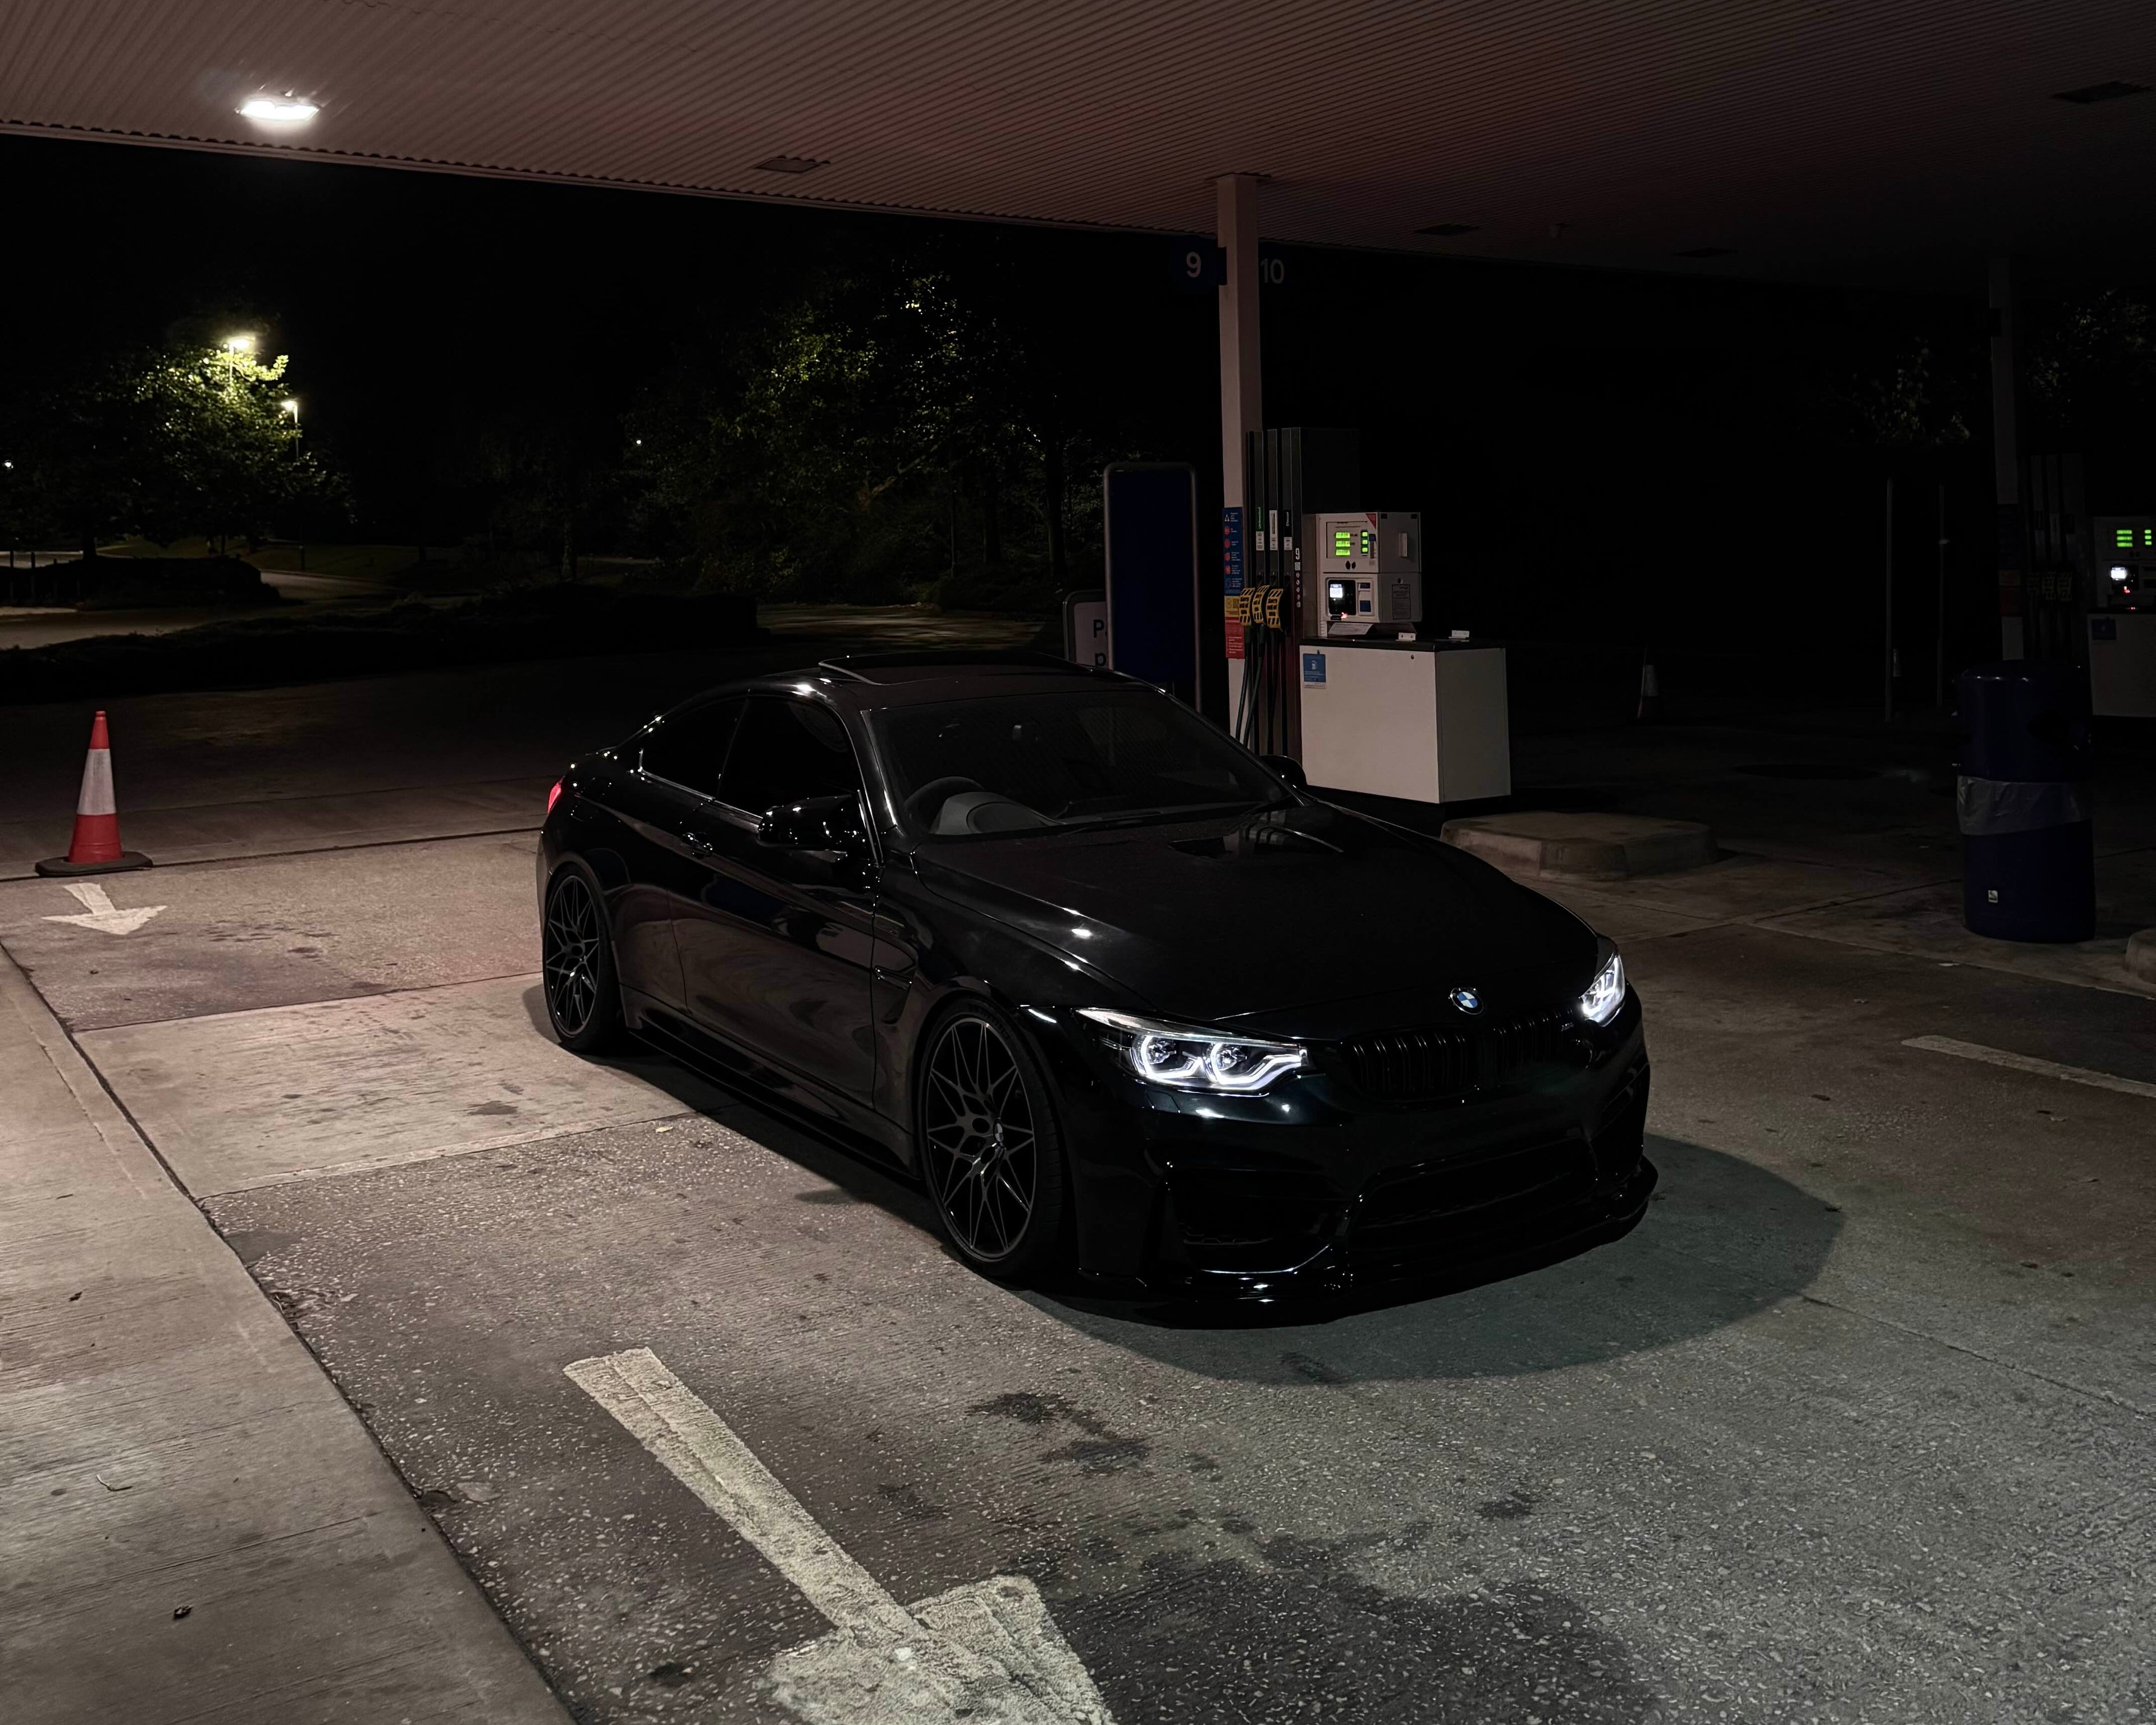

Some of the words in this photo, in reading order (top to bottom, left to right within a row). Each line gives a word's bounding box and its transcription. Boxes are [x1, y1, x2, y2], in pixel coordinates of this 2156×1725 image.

[1186, 251, 1202, 278] 9
[1260, 258, 1285, 283] 10
[1295, 547, 1300, 560] 9
[1093, 619, 1107, 638] P
